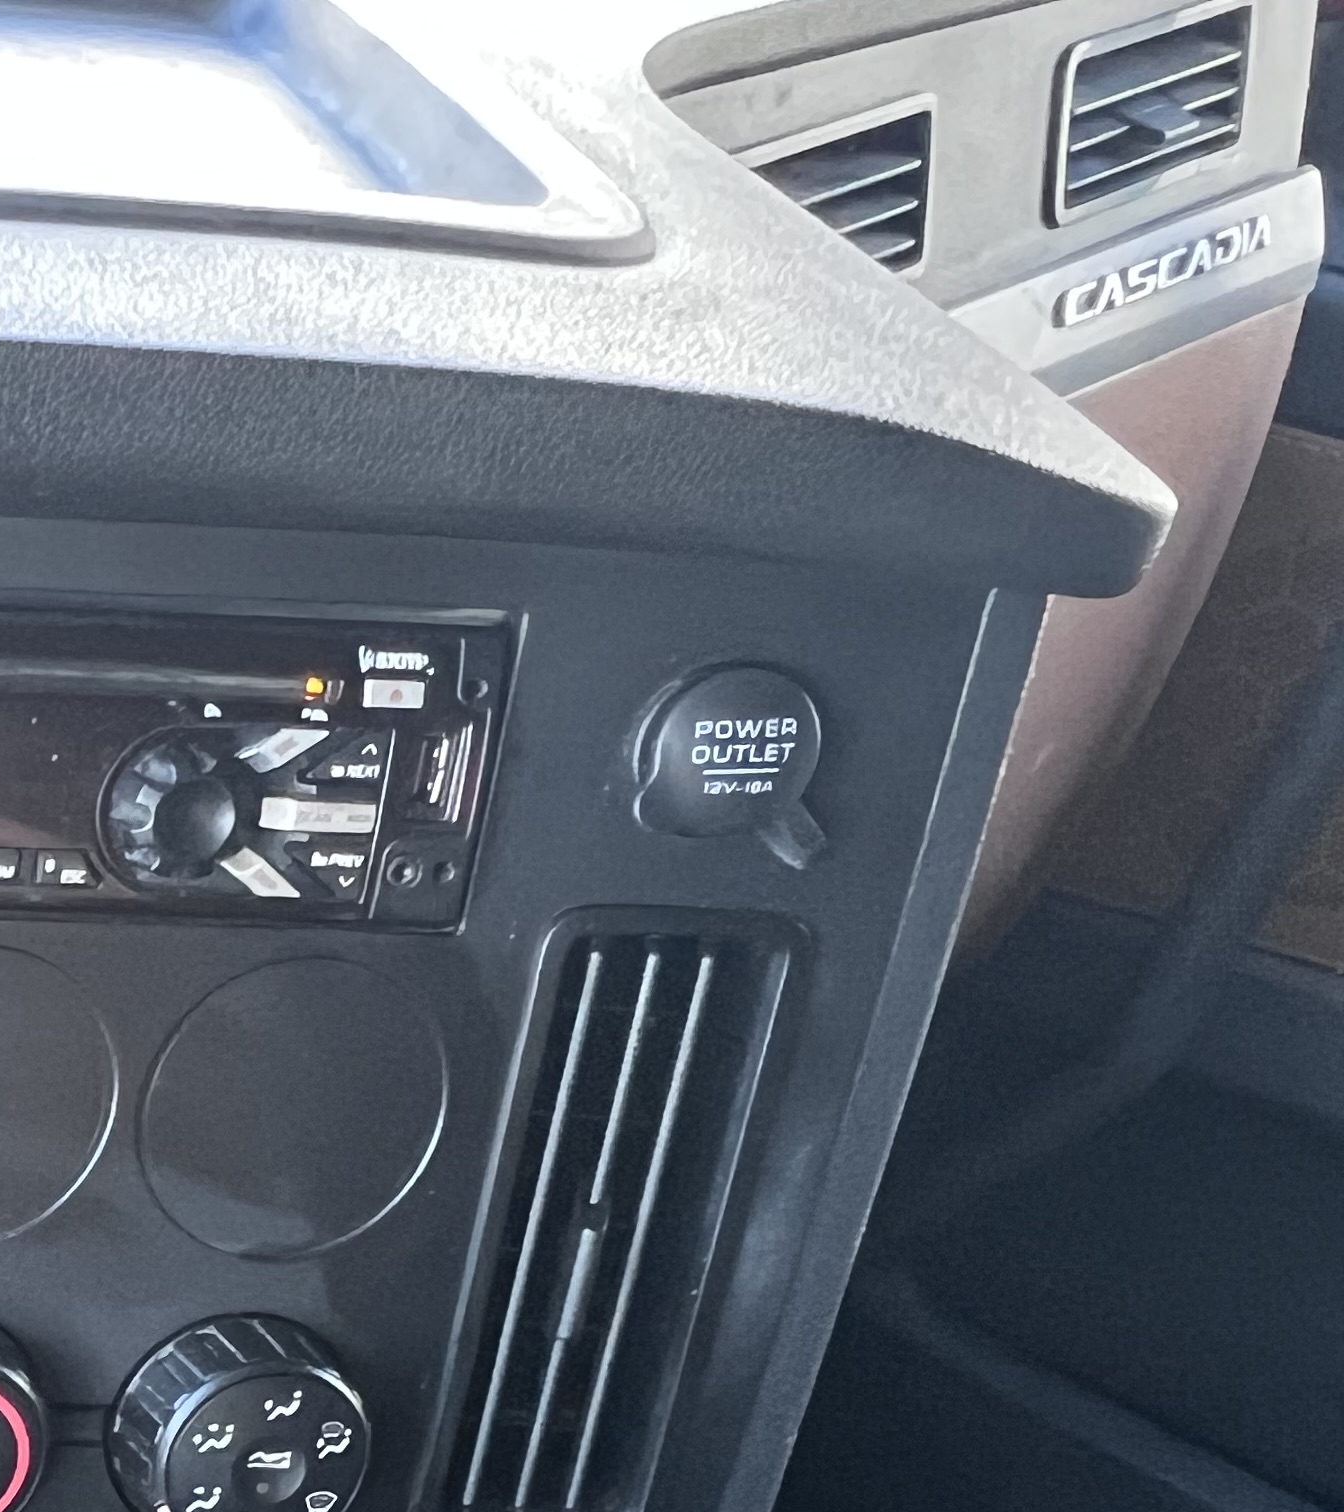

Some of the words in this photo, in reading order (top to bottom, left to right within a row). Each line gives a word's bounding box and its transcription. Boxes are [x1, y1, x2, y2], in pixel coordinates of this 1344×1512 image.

[1065, 213, 1272, 317] CASCADIA
[694, 717, 798, 740] POWER
[691, 742, 796, 765] OUTLET
